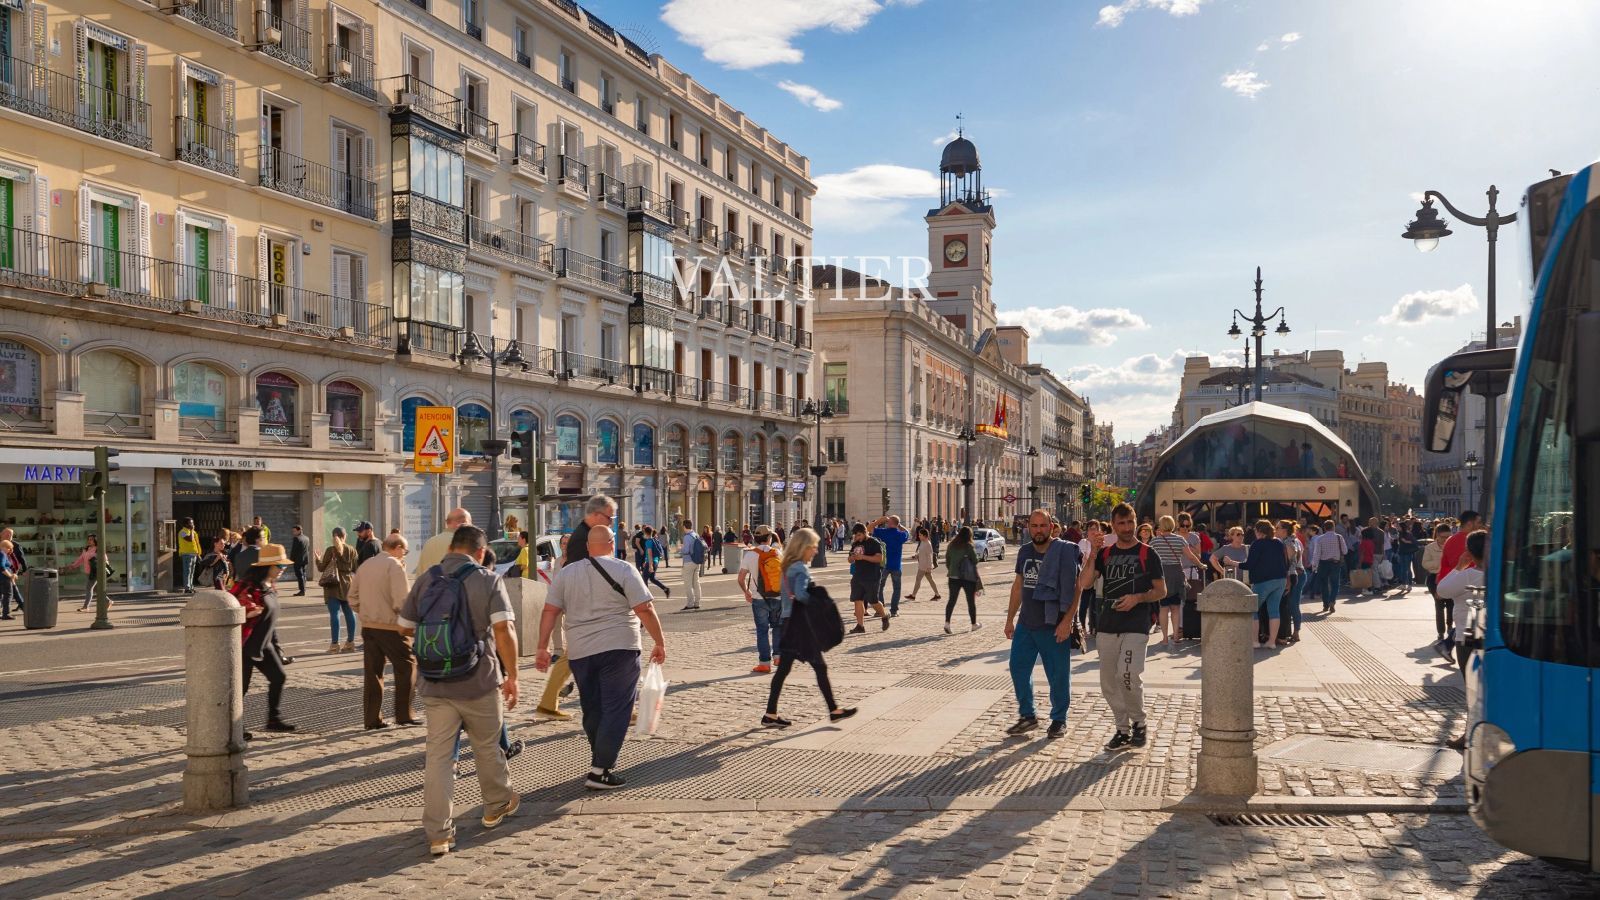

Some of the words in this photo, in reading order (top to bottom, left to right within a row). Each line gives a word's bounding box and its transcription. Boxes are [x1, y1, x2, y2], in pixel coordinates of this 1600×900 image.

[420, 413, 452, 421] ATENCION
[181, 458, 215, 467] PUERTA
[25, 464, 81, 481] MARY
[1241, 486, 1267, 495] SOL
